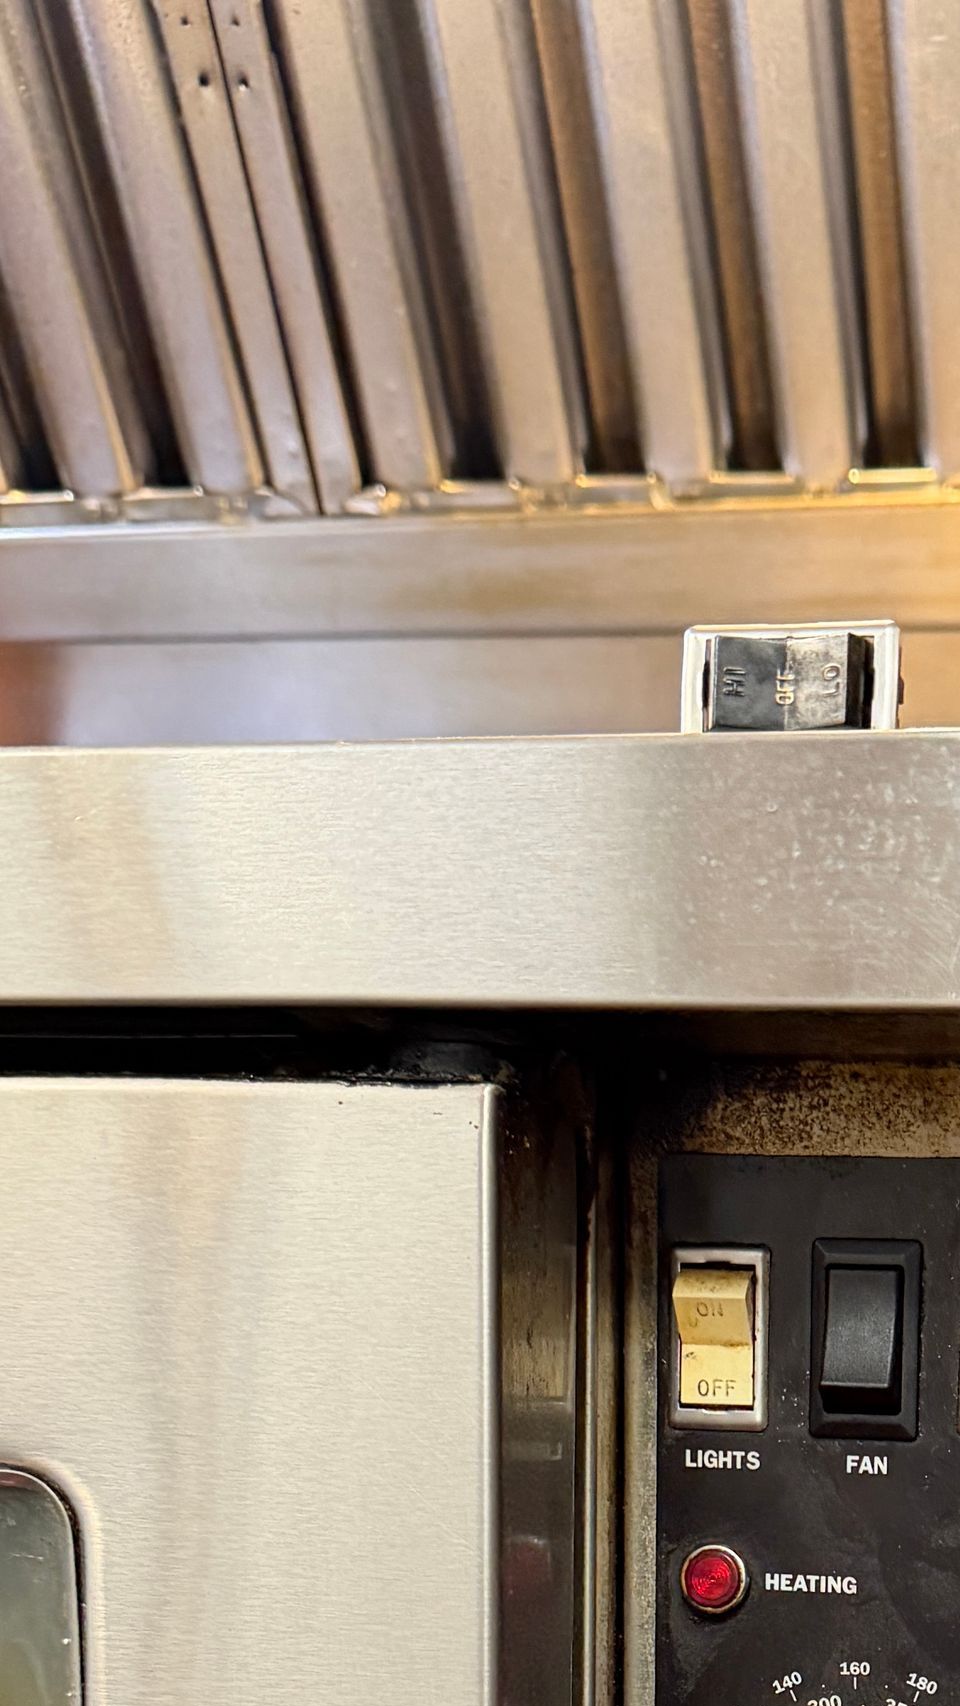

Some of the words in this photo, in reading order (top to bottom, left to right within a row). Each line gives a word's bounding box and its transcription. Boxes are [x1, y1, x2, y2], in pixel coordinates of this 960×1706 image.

[722, 666, 746, 697] HI
[775, 665, 795, 705] OFF
[822, 662, 840, 697] LO
[697, 1379, 736, 1397] OFF
[684, 1450, 760, 1470] LIGHTS
[845, 1455, 888, 1475] FAN
[764, 1573, 857, 1595] HEATING
[839, 1661, 871, 1676] 160
[772, 1671, 803, 1695] 140
[905, 1673, 938, 1695] 180
